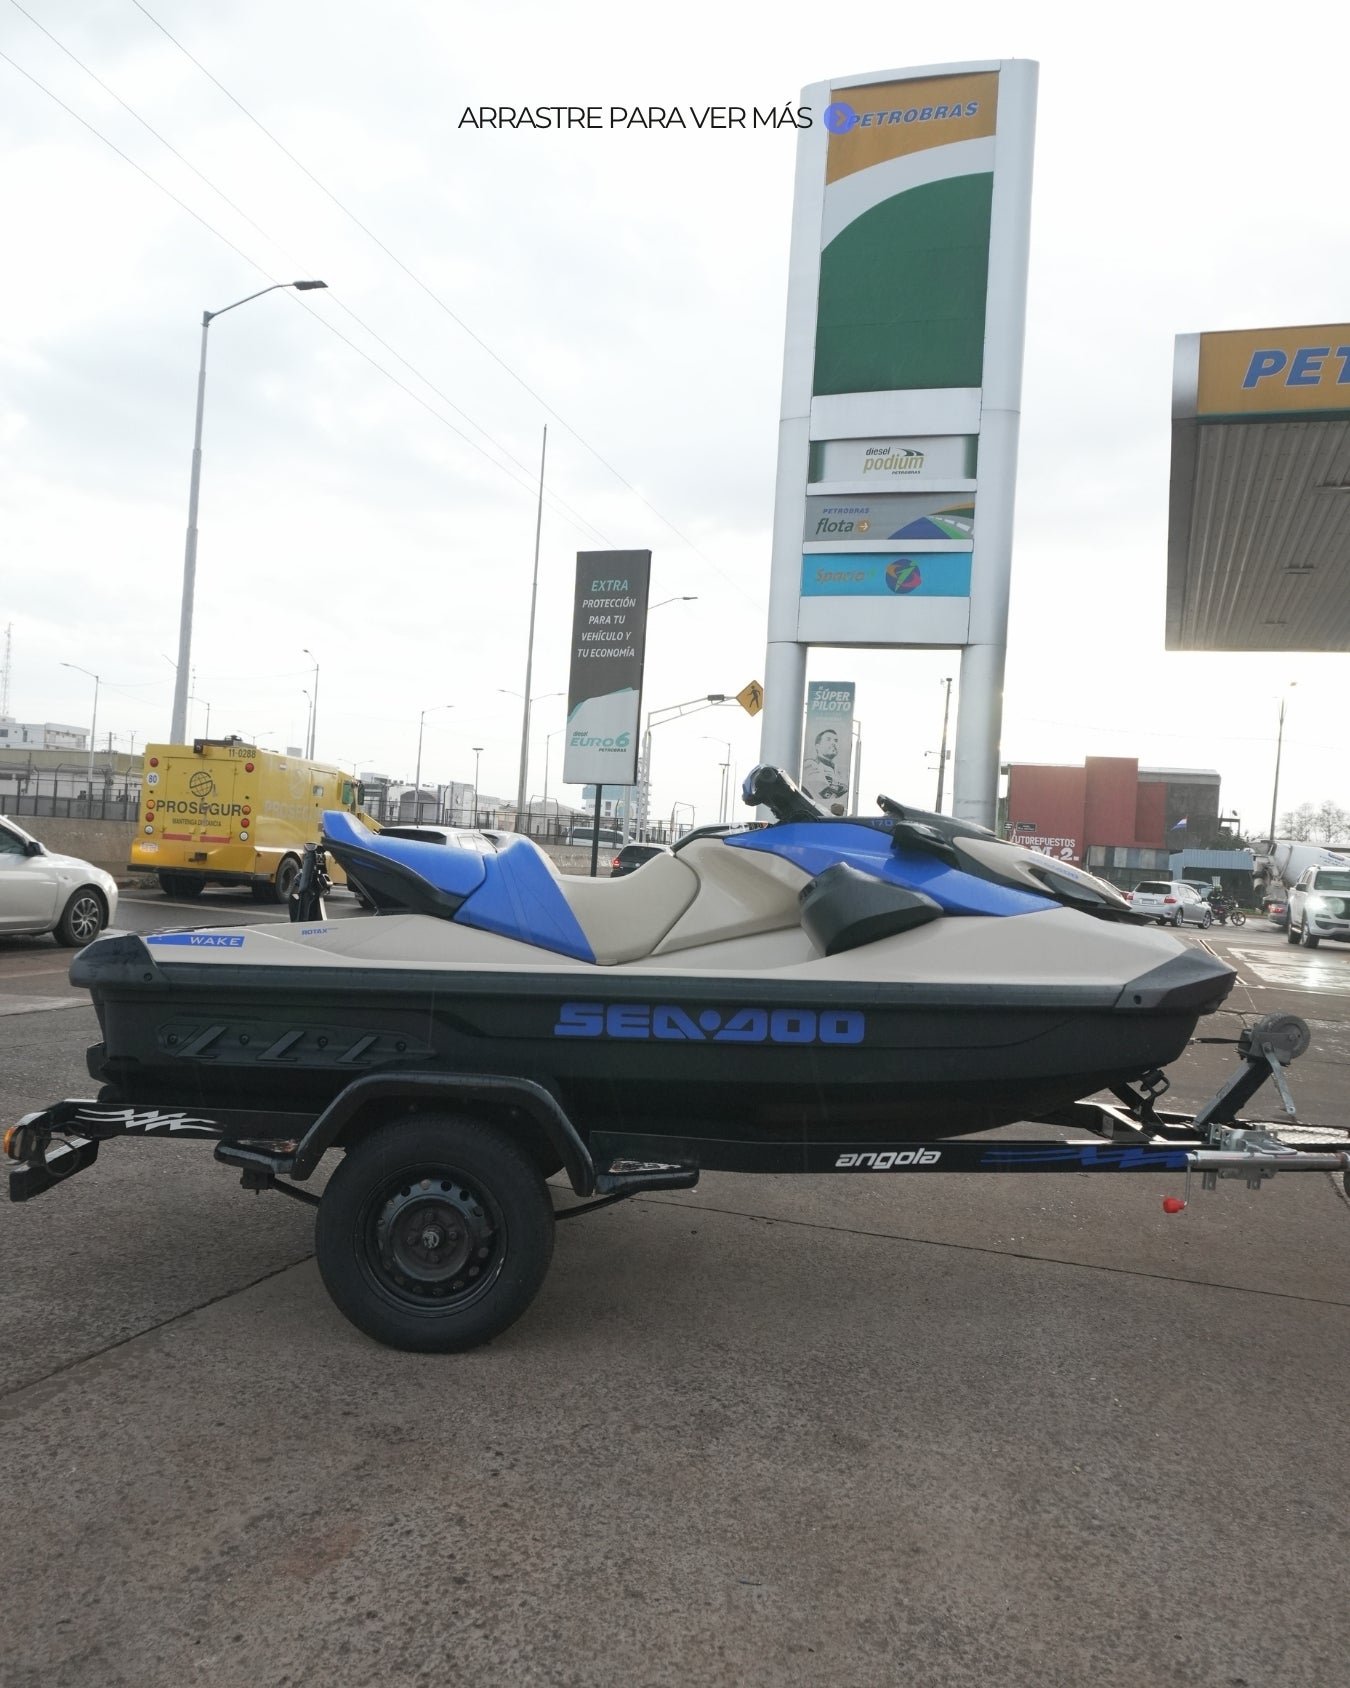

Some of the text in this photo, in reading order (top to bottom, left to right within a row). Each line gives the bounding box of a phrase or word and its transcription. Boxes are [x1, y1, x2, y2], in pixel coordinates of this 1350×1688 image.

[846, 101, 979, 128] PETROBRAS
[866, 447, 891, 456] diesel
[863, 454, 924, 474] podium
[816, 518, 854, 535] flota
[591, 580, 629, 592] EXTRA
[582, 596, 637, 608] PROTECCIÓN
[588, 615, 626, 625] PARA TU
[581, 630, 632, 641] VEHÍCULO Y
[577, 646, 635, 658] TU ECONOMÍA
[814, 688, 850, 701] SÚPER
[811, 700, 851, 711] PILOTO
[228, 749, 256, 758] 11-0288
[156, 800, 242, 816] PROSEGUR
[190, 936, 241, 946] WAKE
[835, 1148, 942, 1170] angola
